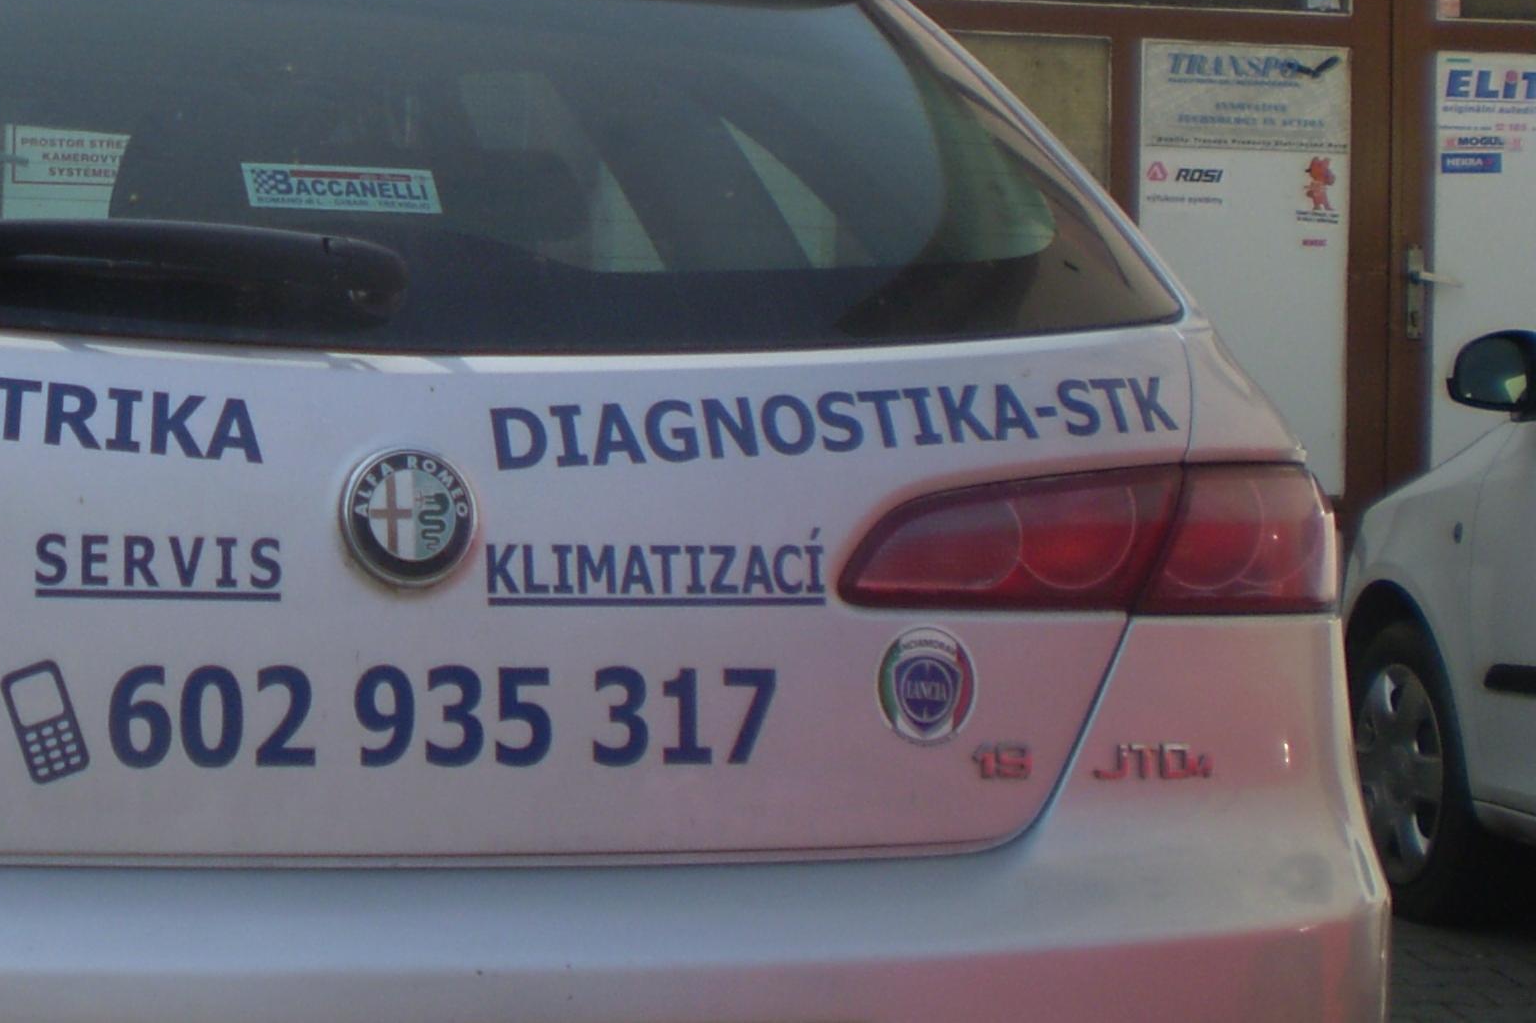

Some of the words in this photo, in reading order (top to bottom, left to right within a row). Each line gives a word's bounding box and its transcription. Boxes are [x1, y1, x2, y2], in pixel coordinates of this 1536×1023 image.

[20, 137, 85, 148] PROSTOR
[264, 169, 430, 201] BACCANELLI
[1175, 168, 1224, 183] ROSI
[489, 376, 1180, 471] DIAGNOSTIKA-STK
[354, 462, 394, 518] ALFA
[407, 455, 469, 518] ROMEO
[34, 532, 283, 590] SERVIS
[485, 527, 827, 595] KLIMATIZACÍ
[107, 664, 317, 769] 602
[353, 664, 553, 769] 935
[592, 665, 778, 768] 317
